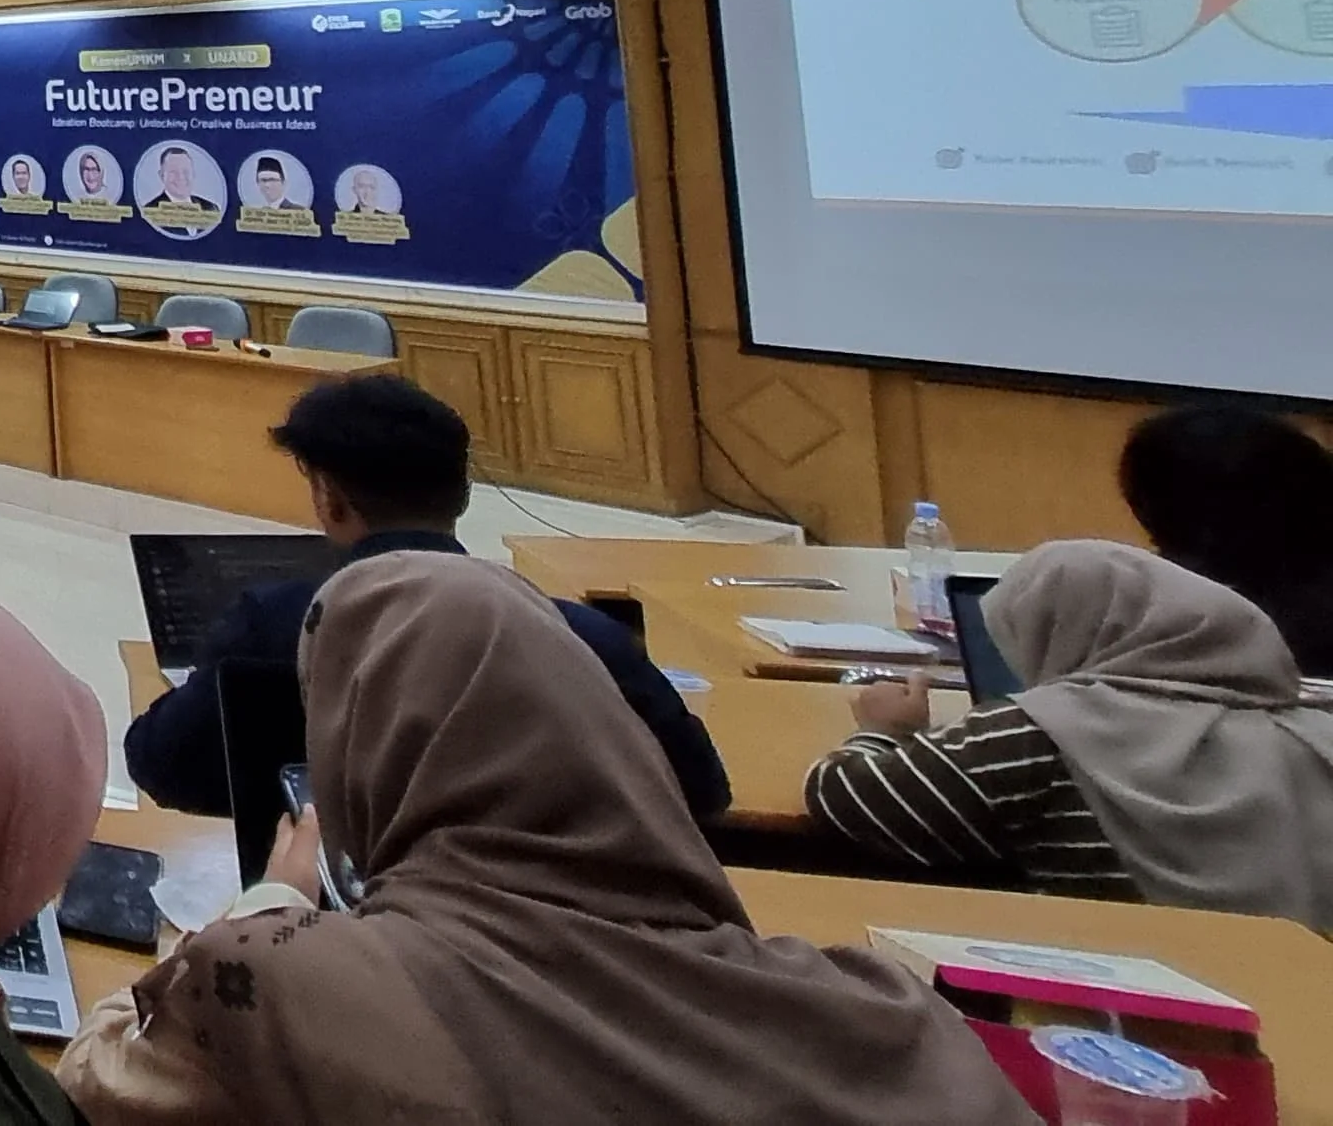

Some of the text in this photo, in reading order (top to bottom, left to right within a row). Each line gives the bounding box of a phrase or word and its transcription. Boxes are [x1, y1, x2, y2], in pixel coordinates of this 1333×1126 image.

[565, 2, 613, 20] Grab
[208, 50, 259, 64] UNAND
[45, 77, 322, 112] FuturePreneur
[52, 117, 87, 128] Ideation
[139, 118, 188, 131] Unlocking
[190, 117, 232, 129] Creative
[235, 117, 282, 130] Business
[285, 119, 317, 130] Ideas
